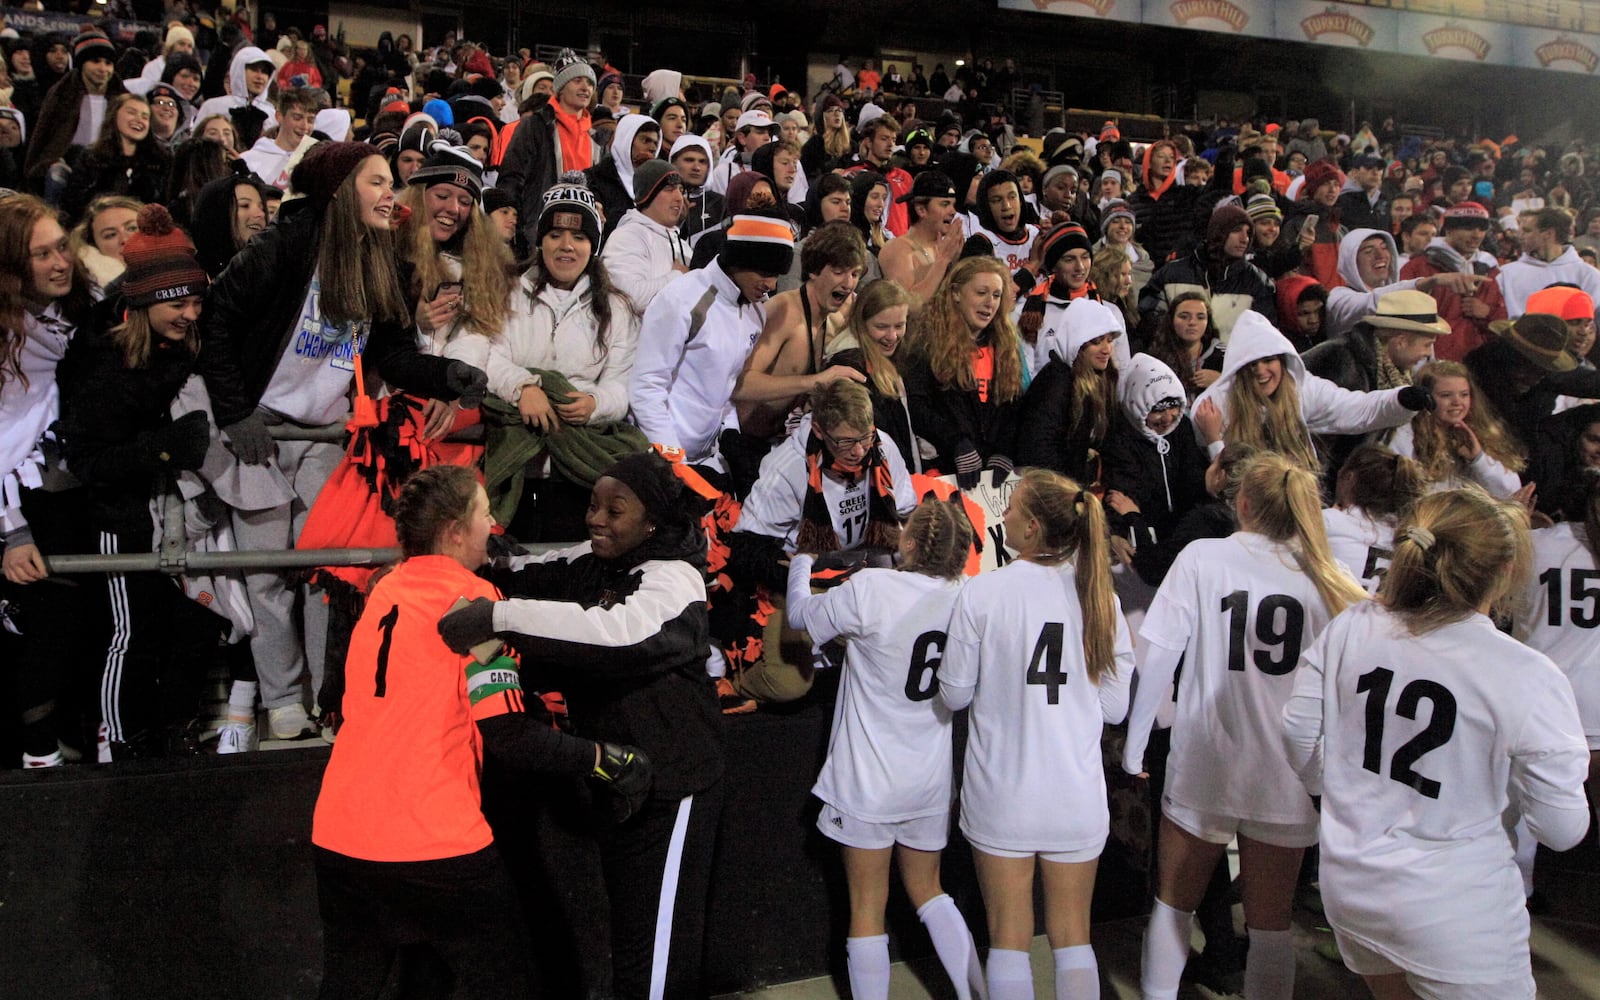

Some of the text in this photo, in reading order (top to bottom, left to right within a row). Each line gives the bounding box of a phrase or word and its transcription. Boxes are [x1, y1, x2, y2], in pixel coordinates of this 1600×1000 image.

[1304, 15, 1370, 41] TURKEY HILL
[1425, 30, 1487, 55] TURKEY HILL
[155, 285, 190, 300] CREEK
[842, 509, 867, 545] 17
[1539, 567, 1600, 629] 15
[374, 604, 399, 698] 1
[904, 630, 948, 702] 6
[1026, 622, 1068, 705] 4
[1220, 589, 1304, 676] 19
[1356, 666, 1457, 800] 12
